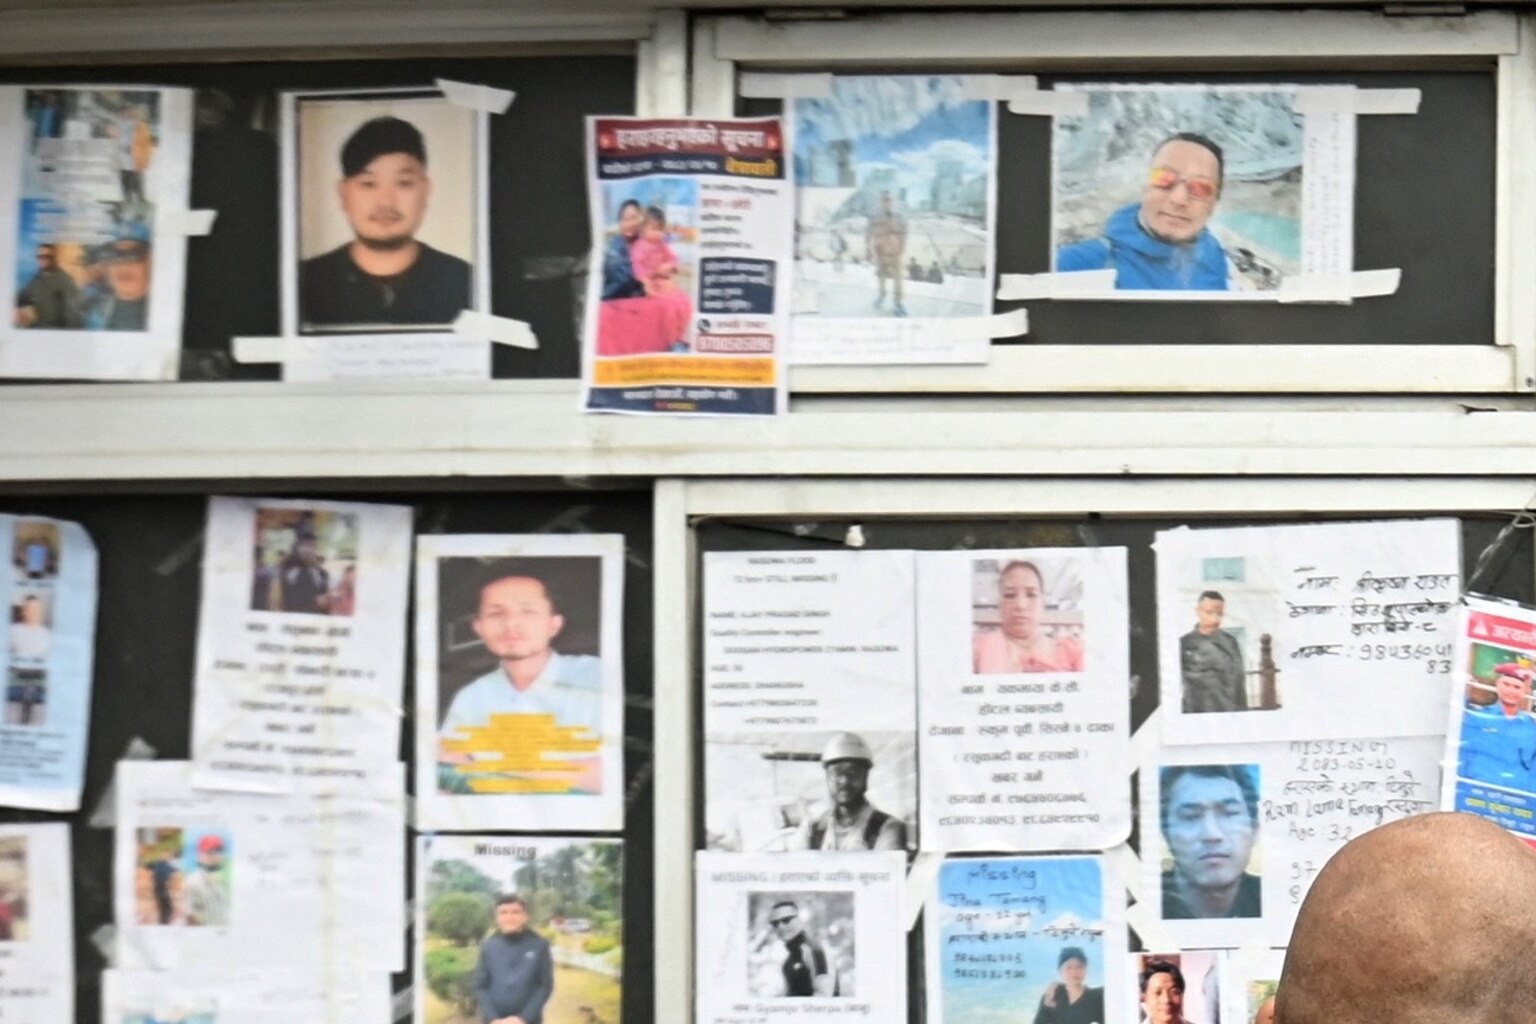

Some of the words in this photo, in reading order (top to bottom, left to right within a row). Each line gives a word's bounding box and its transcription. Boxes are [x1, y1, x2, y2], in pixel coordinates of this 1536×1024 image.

[1427, 660, 1452, 674] 83
[1289, 741, 1387, 755] MISSING
[473, 842, 537, 858] Missing
[712, 872, 768, 883] MISSING
[968, 863, 1036, 890] Missing
[989, 892, 1046, 914] Tamang
